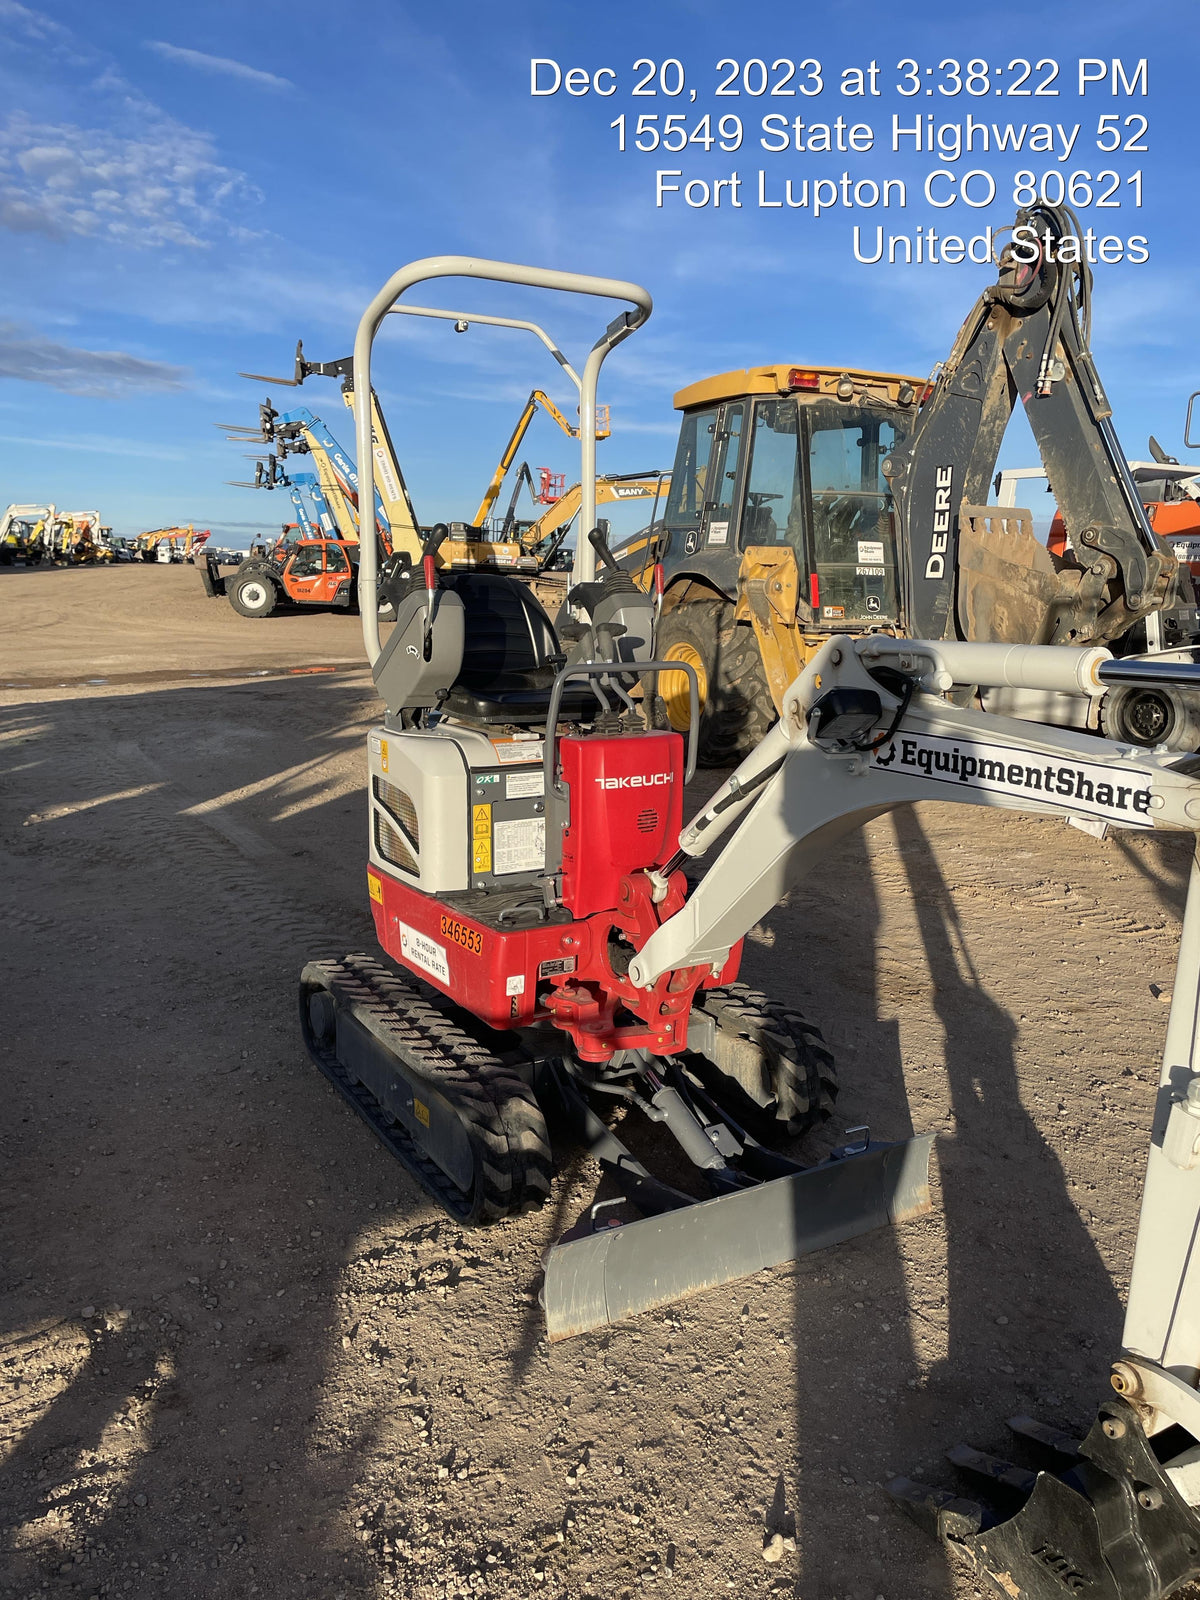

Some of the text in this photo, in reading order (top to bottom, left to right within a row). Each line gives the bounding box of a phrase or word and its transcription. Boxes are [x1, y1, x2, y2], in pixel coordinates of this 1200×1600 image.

[618, 488, 644, 496] SANY
[925, 466, 953, 579] DEERE
[1176, 541, 1200, 550] Equip
[901, 739, 1150, 813] EquipmentShare
[441, 916, 482, 954] 346553
[410, 947, 446, 976] RENTAL RATE
